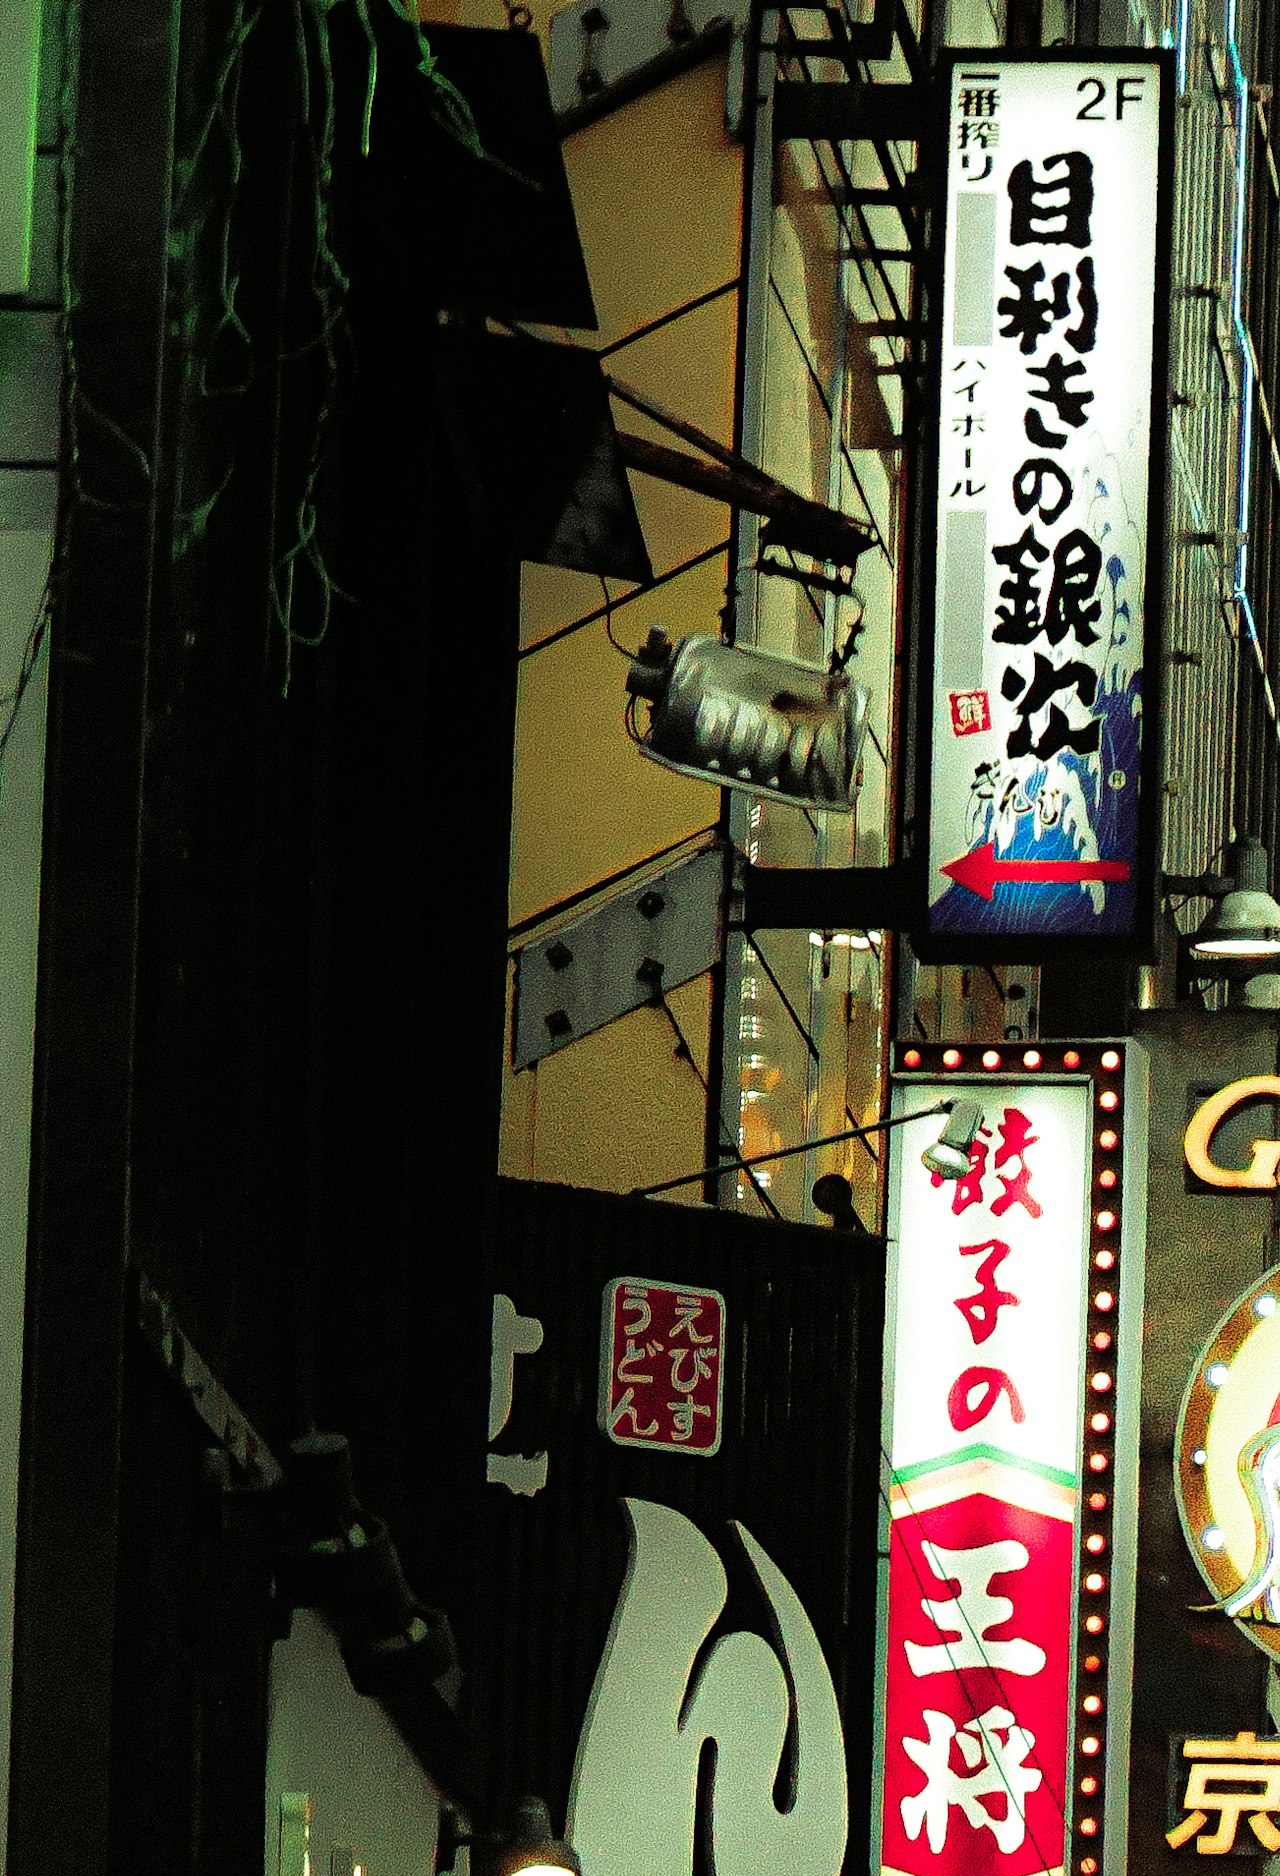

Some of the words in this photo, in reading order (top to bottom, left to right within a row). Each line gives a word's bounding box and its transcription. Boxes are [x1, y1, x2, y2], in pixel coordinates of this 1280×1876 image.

[956, 72, 1001, 183] 一番搾り
[1075, 77, 1147, 122] 2F
[948, 356, 989, 499] ハイボール
[991, 152, 1104, 761] 目利きの銀次
[610, 1286, 664, 1438] うどん
[666, 1286, 718, 1444] えびす
